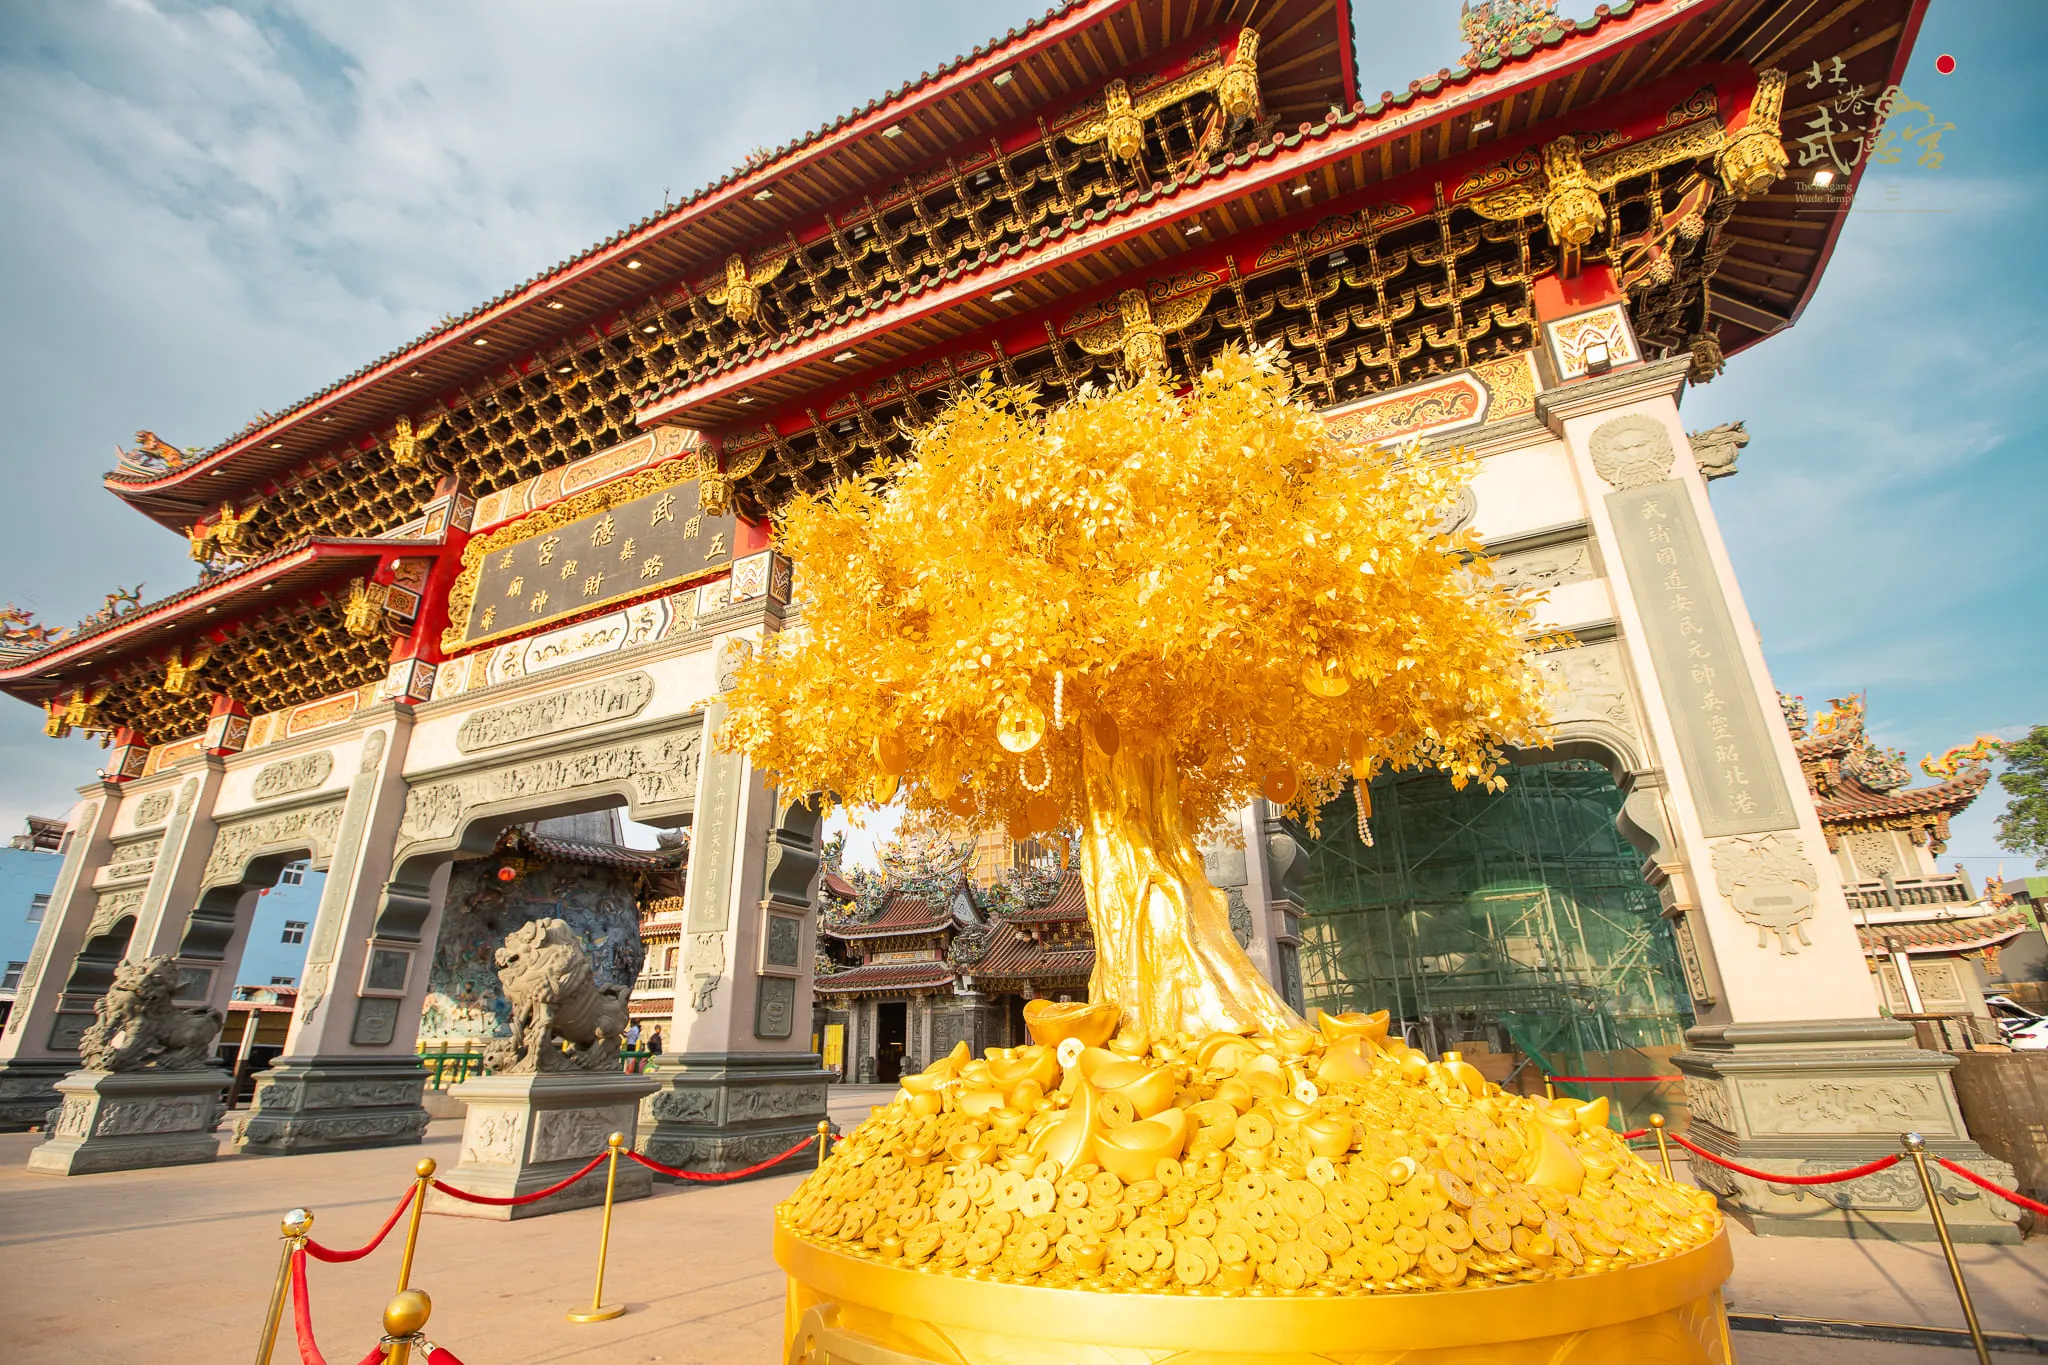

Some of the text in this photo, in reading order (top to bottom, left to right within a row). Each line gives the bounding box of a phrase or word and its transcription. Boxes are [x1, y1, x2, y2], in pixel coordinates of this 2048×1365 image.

[505, 514, 702, 599] 開基祖廟
[538, 492, 677, 566] 武德宮
